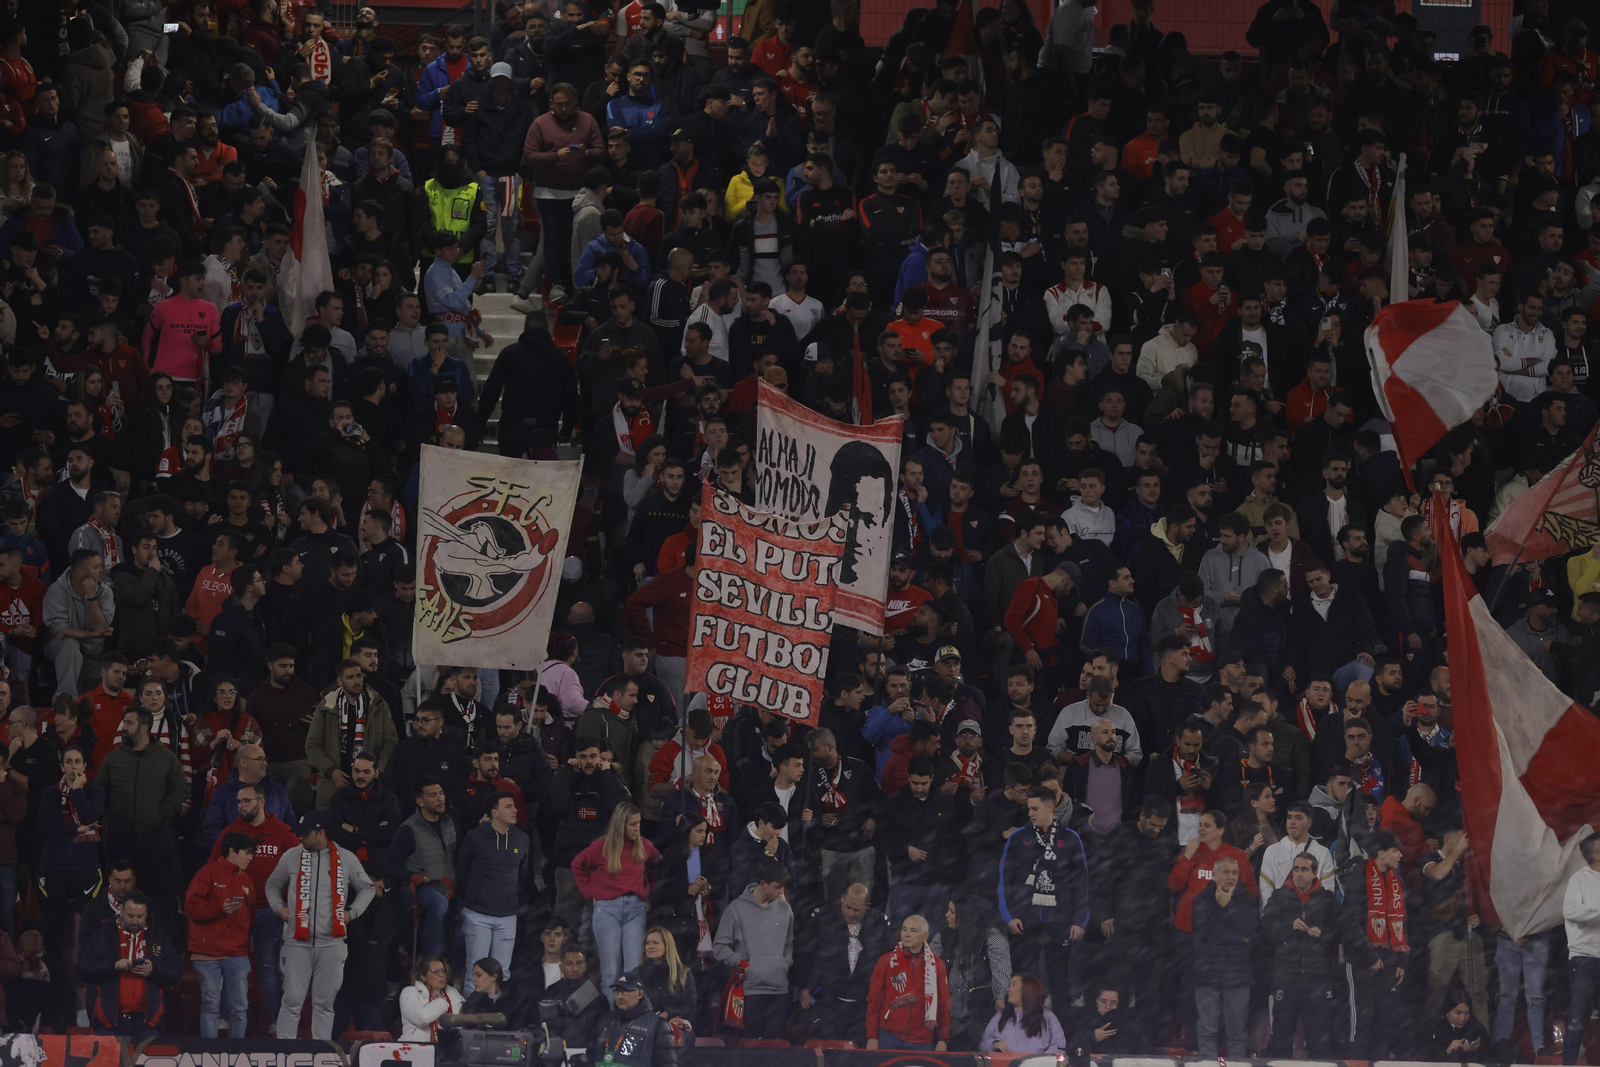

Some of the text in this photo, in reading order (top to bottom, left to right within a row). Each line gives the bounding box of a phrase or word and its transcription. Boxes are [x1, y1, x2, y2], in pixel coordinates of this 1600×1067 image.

[931, 309, 959, 317] DEGIRO
[701, 520, 748, 565] EL
[165, 548, 186, 571] SPORTIF
[201, 579, 233, 595] SILBON
[696, 567, 836, 635] SEVILL
[886, 600, 912, 611] NIKE
[910, 657, 929, 669] NIKE
[705, 661, 813, 720] CLUB
